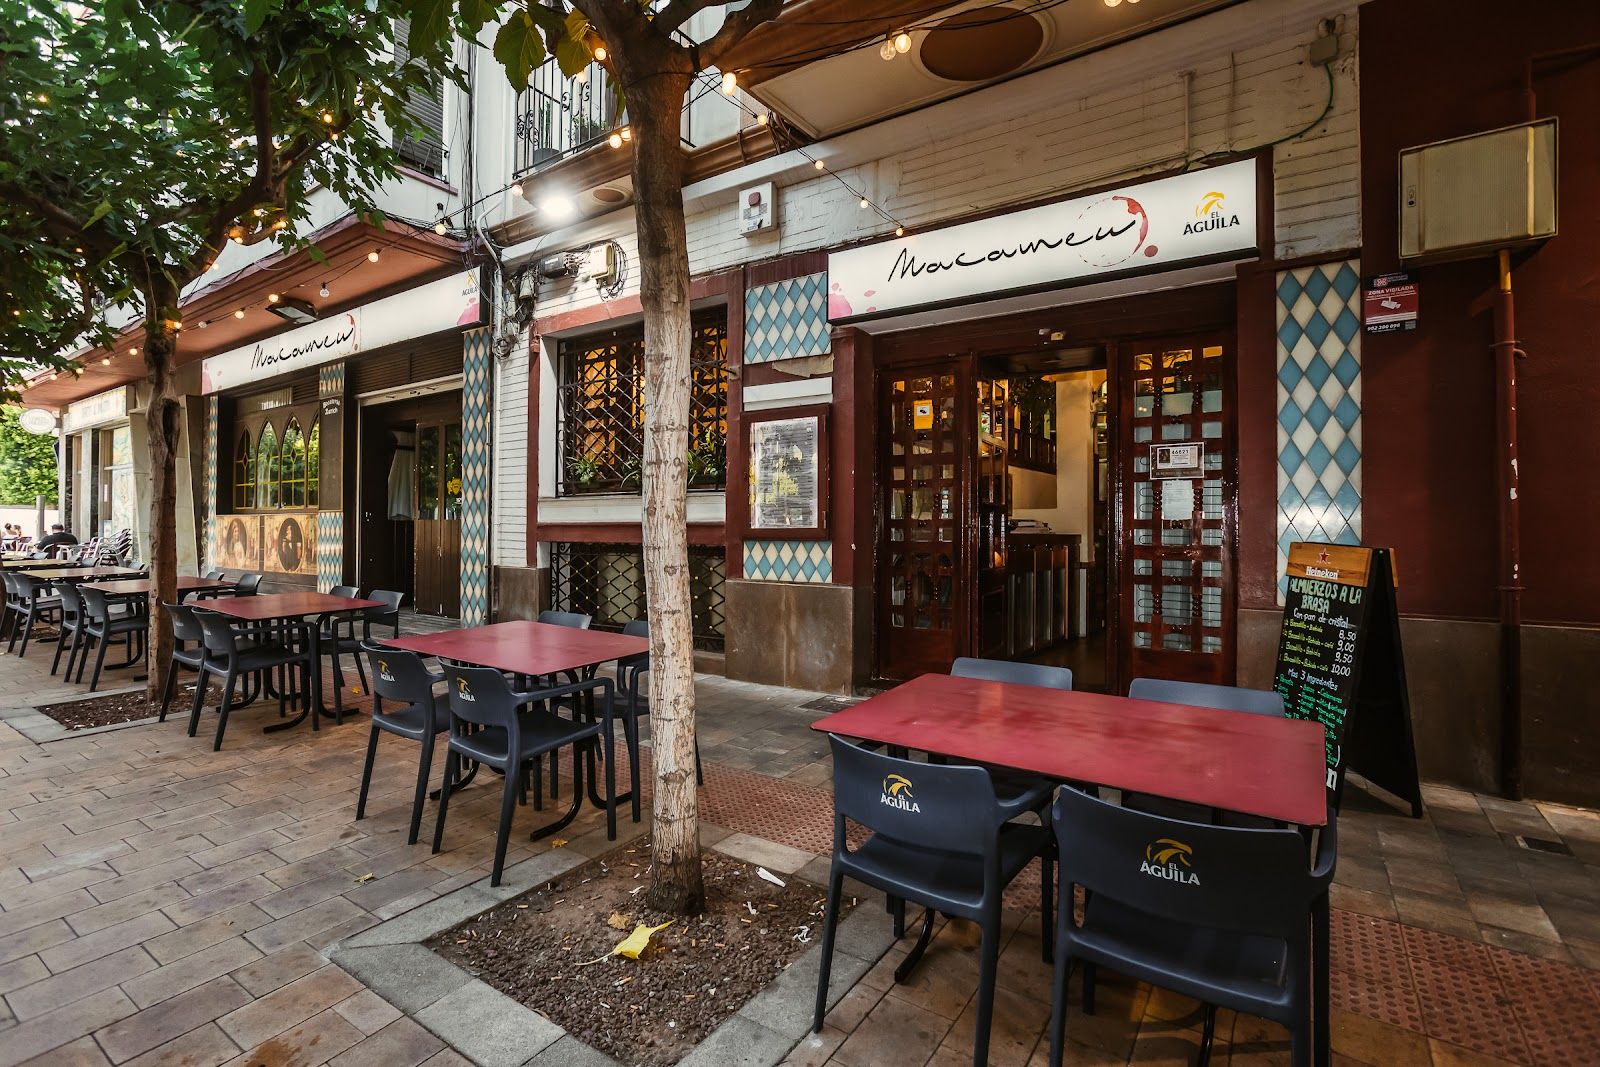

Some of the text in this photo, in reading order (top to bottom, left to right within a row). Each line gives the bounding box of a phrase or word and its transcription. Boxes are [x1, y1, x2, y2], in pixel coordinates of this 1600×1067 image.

[1385, 285, 1414, 293] VIGILADA
[1305, 566, 1339, 580] Heineken
[1289, 578, 1362, 605] ALMUERZOS A LA
[1301, 595, 1330, 614] BRASA
[1338, 630, 1357, 641] 8,50
[1336, 640, 1355, 653] 9,00
[1334, 652, 1353, 664] 9,50
[1300, 670, 1306, 680] 3
[1331, 663, 1351, 677] 10,00
[1168, 862, 1179, 871] EL
